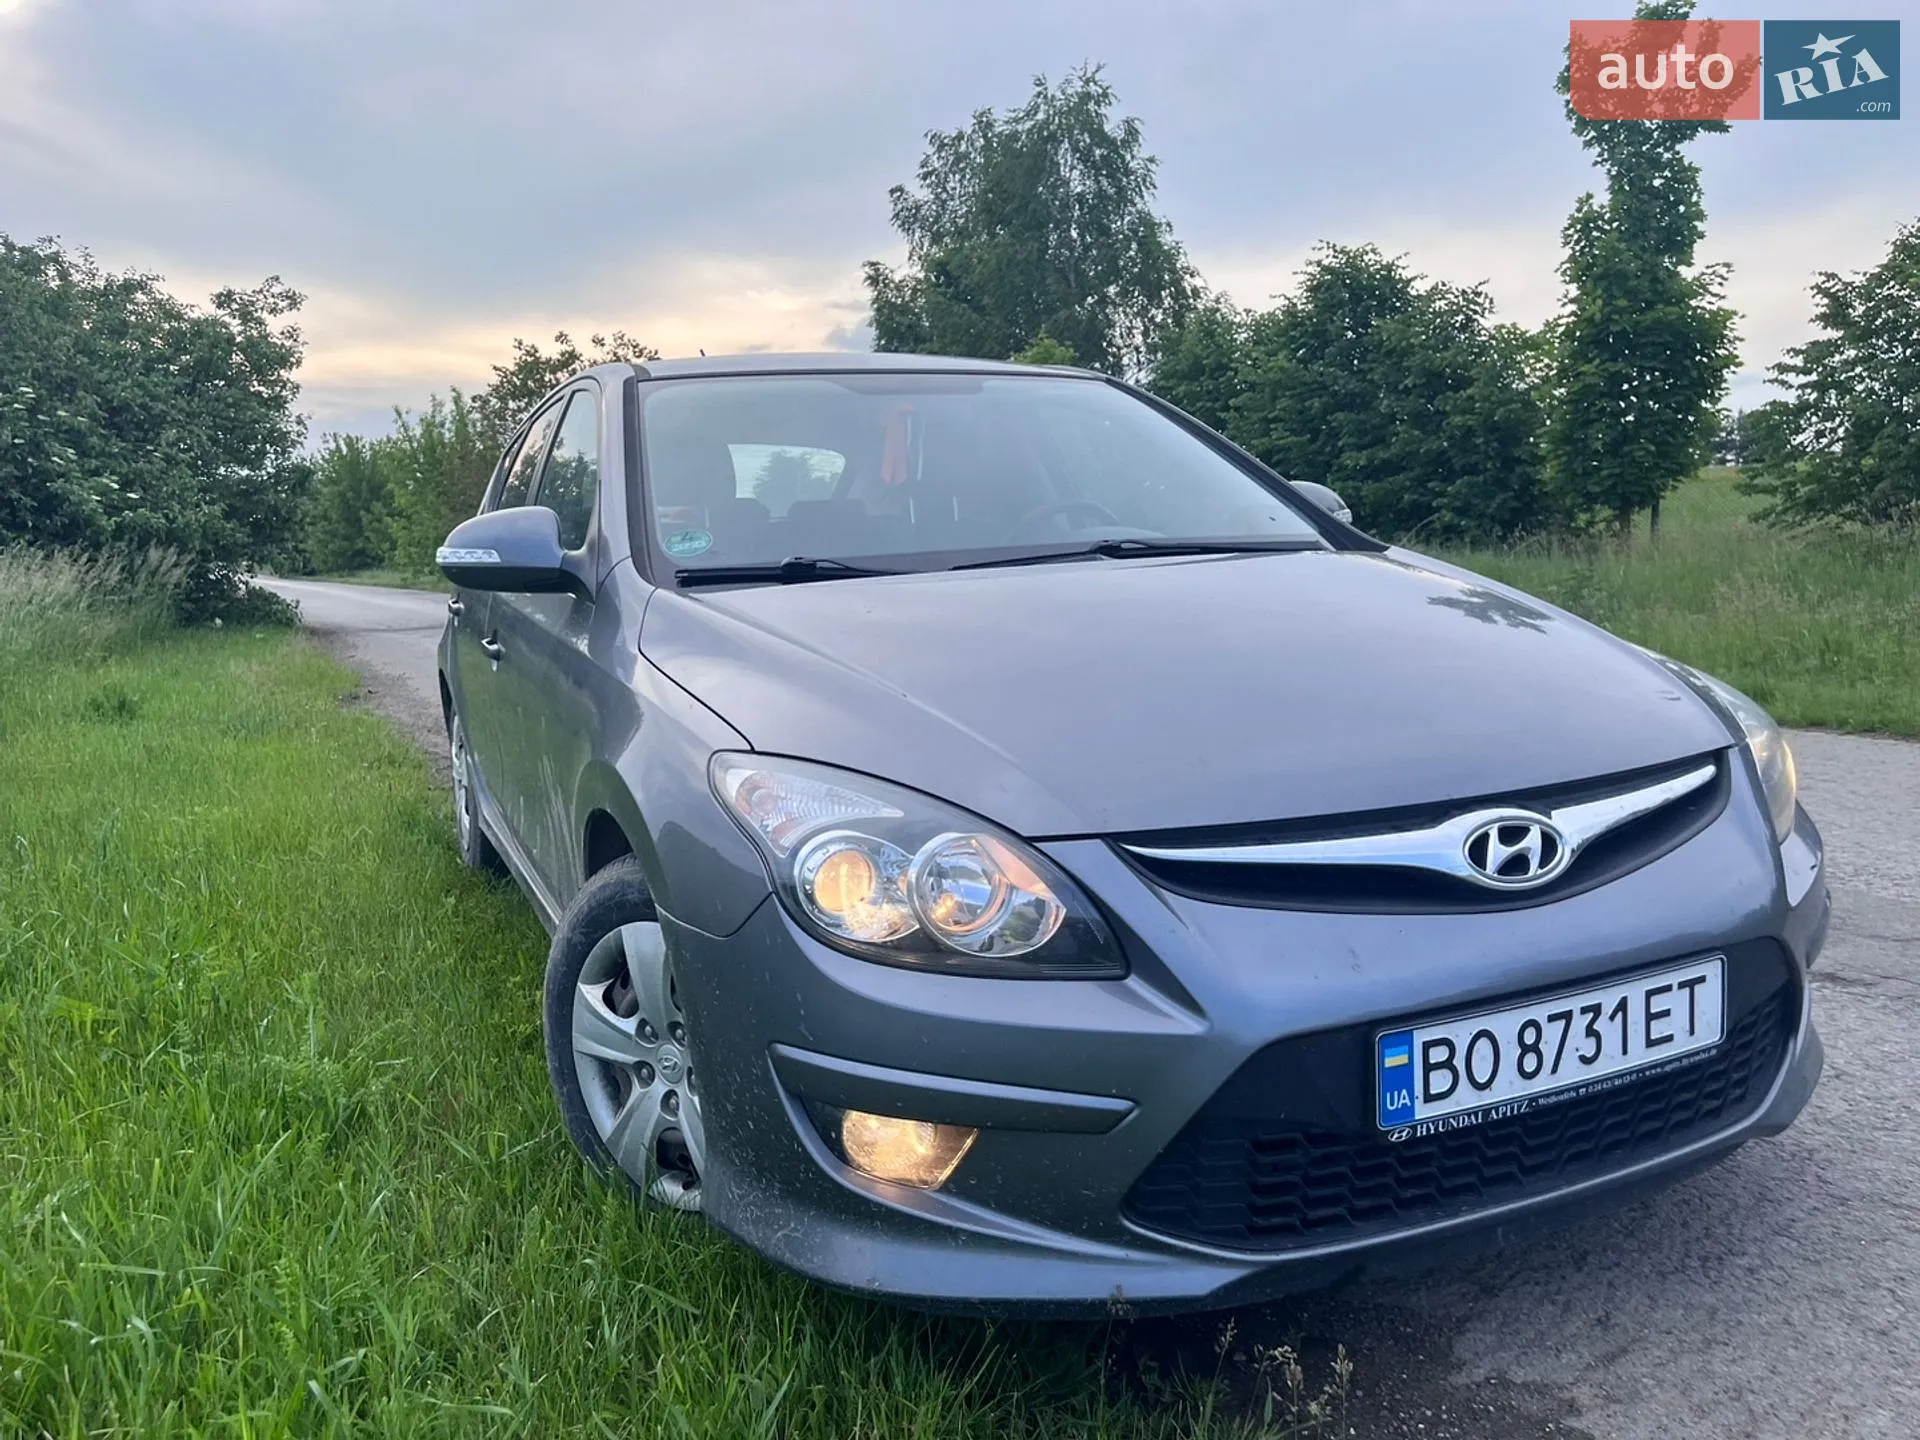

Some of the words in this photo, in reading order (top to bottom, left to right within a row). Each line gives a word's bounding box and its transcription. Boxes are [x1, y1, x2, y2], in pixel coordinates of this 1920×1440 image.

[1421, 1028, 1501, 1104] BO
[1516, 995, 1630, 1081] 8731
[1644, 975, 1706, 1049] ET
[1386, 1089, 1411, 1111] UA
[1415, 1111, 1483, 1138] HYUNDAI
[1487, 1100, 1530, 1121] APITZ
